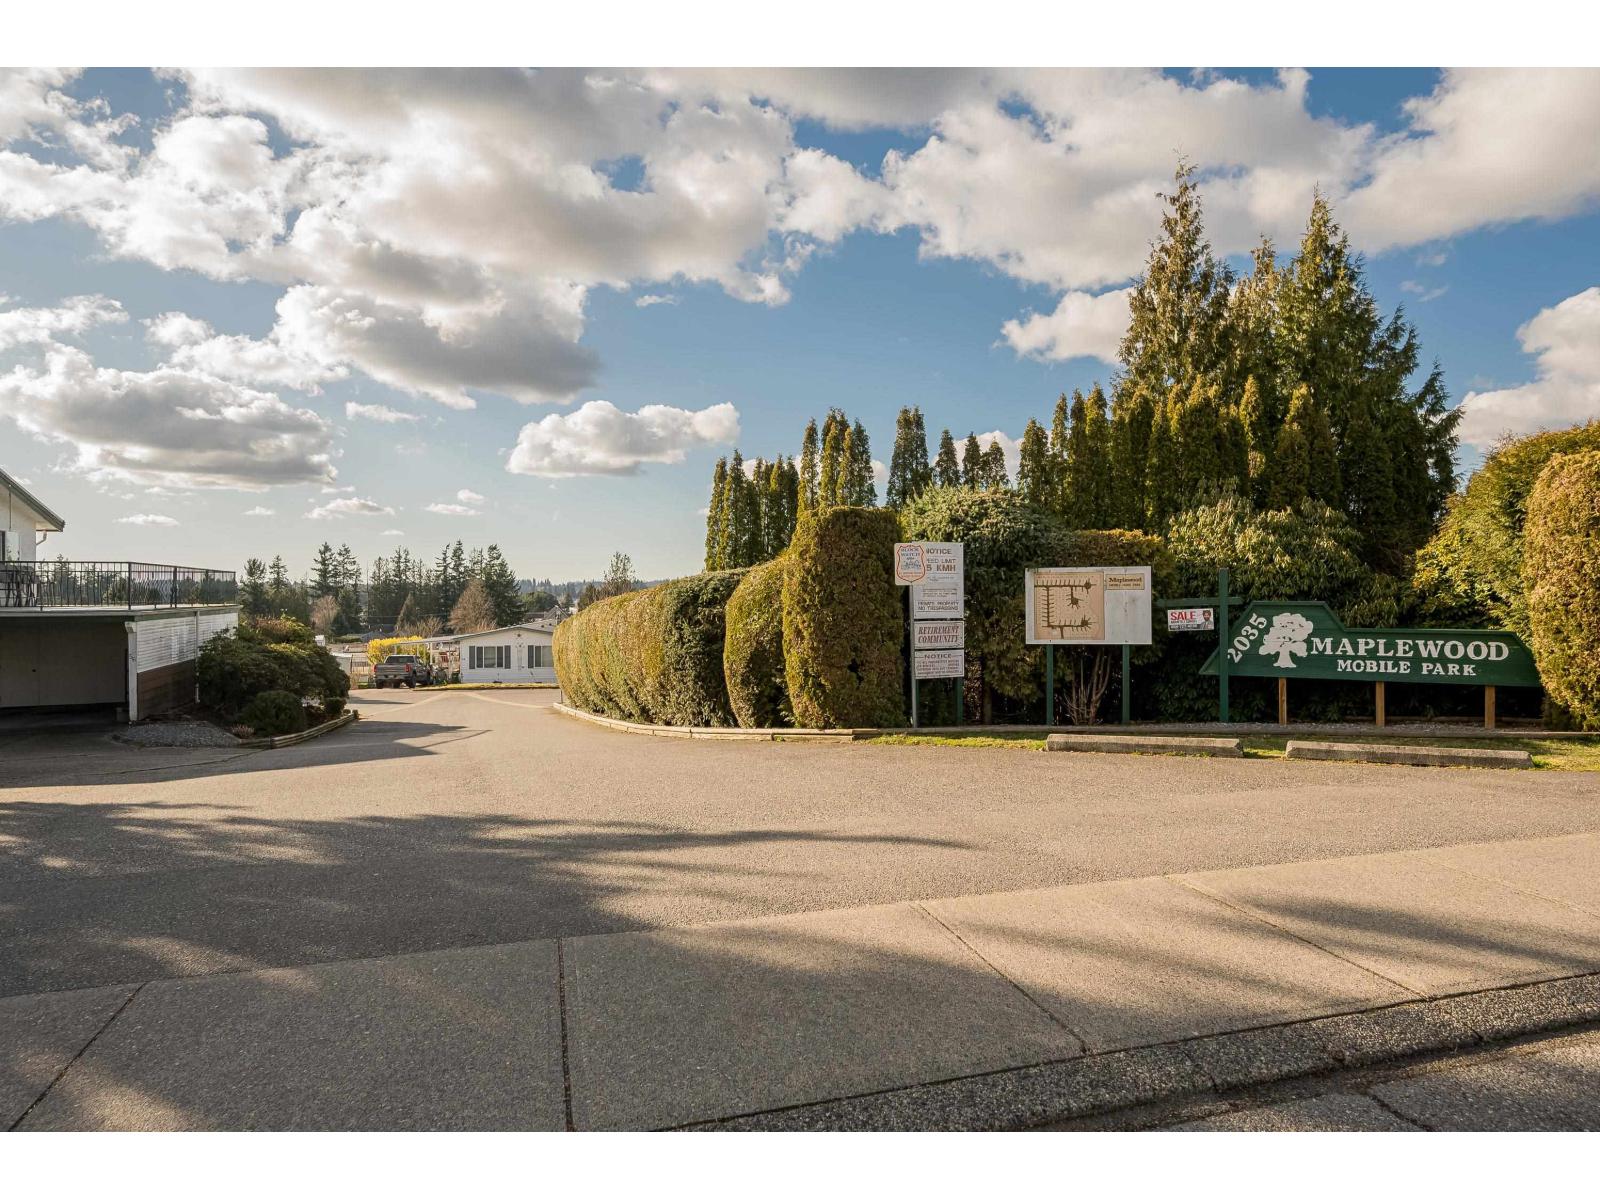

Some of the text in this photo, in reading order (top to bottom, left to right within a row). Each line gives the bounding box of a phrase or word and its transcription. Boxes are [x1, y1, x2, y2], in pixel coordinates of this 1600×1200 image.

[937, 564, 956, 572] KMH
[1170, 611, 1197, 620] SALE
[918, 626, 959, 635] RETIREMENT
[918, 635, 959, 643] COMMUNITY
[1228, 613, 1267, 663] 2035
[1310, 637, 1509, 661] MAPLEWOOD
[1337, 659, 1476, 676] MOBILE PARK
